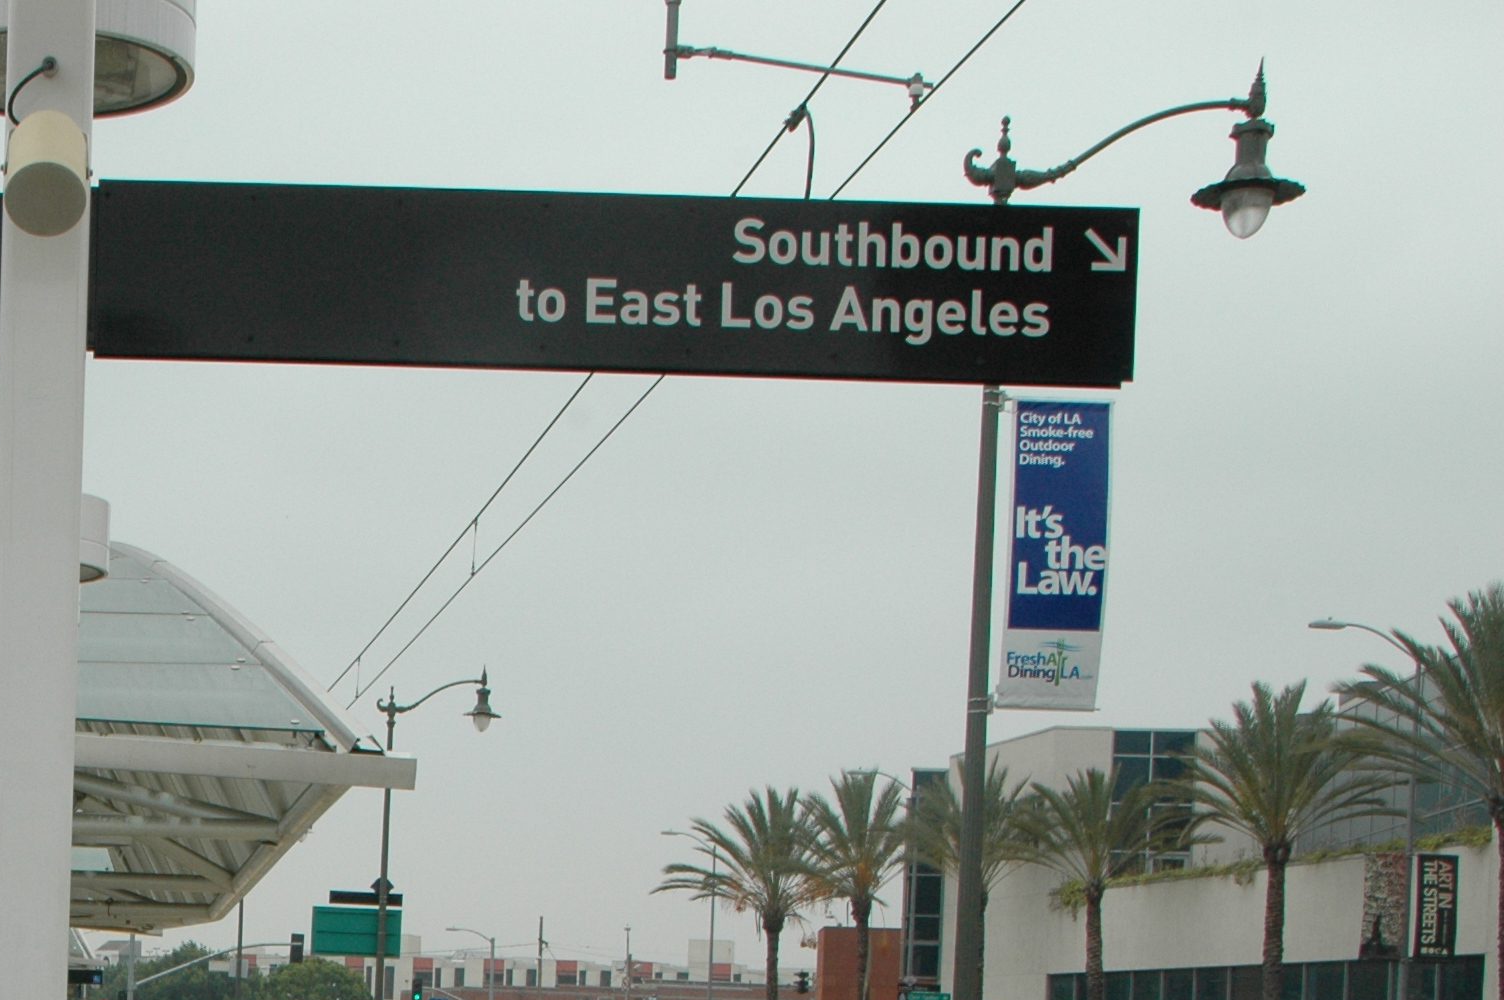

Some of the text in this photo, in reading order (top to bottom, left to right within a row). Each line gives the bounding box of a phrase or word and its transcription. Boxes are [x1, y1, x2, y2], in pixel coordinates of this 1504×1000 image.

[732, 218, 1053, 272] Southbound
[516, 277, 1051, 346] to East Los Angeles
[1020, 411, 1081, 426] City of LA
[1020, 425, 1094, 439] Smoke-free
[1019, 439, 1075, 451] Outdoor
[1019, 453, 1065, 468] Dining.
[1016, 505, 1064, 538] It's
[1044, 535, 1109, 571] the
[1016, 562, 1097, 596] Law.
[1438, 860, 1453, 890] ART
[1420, 860, 1438, 944] THE STREETS
